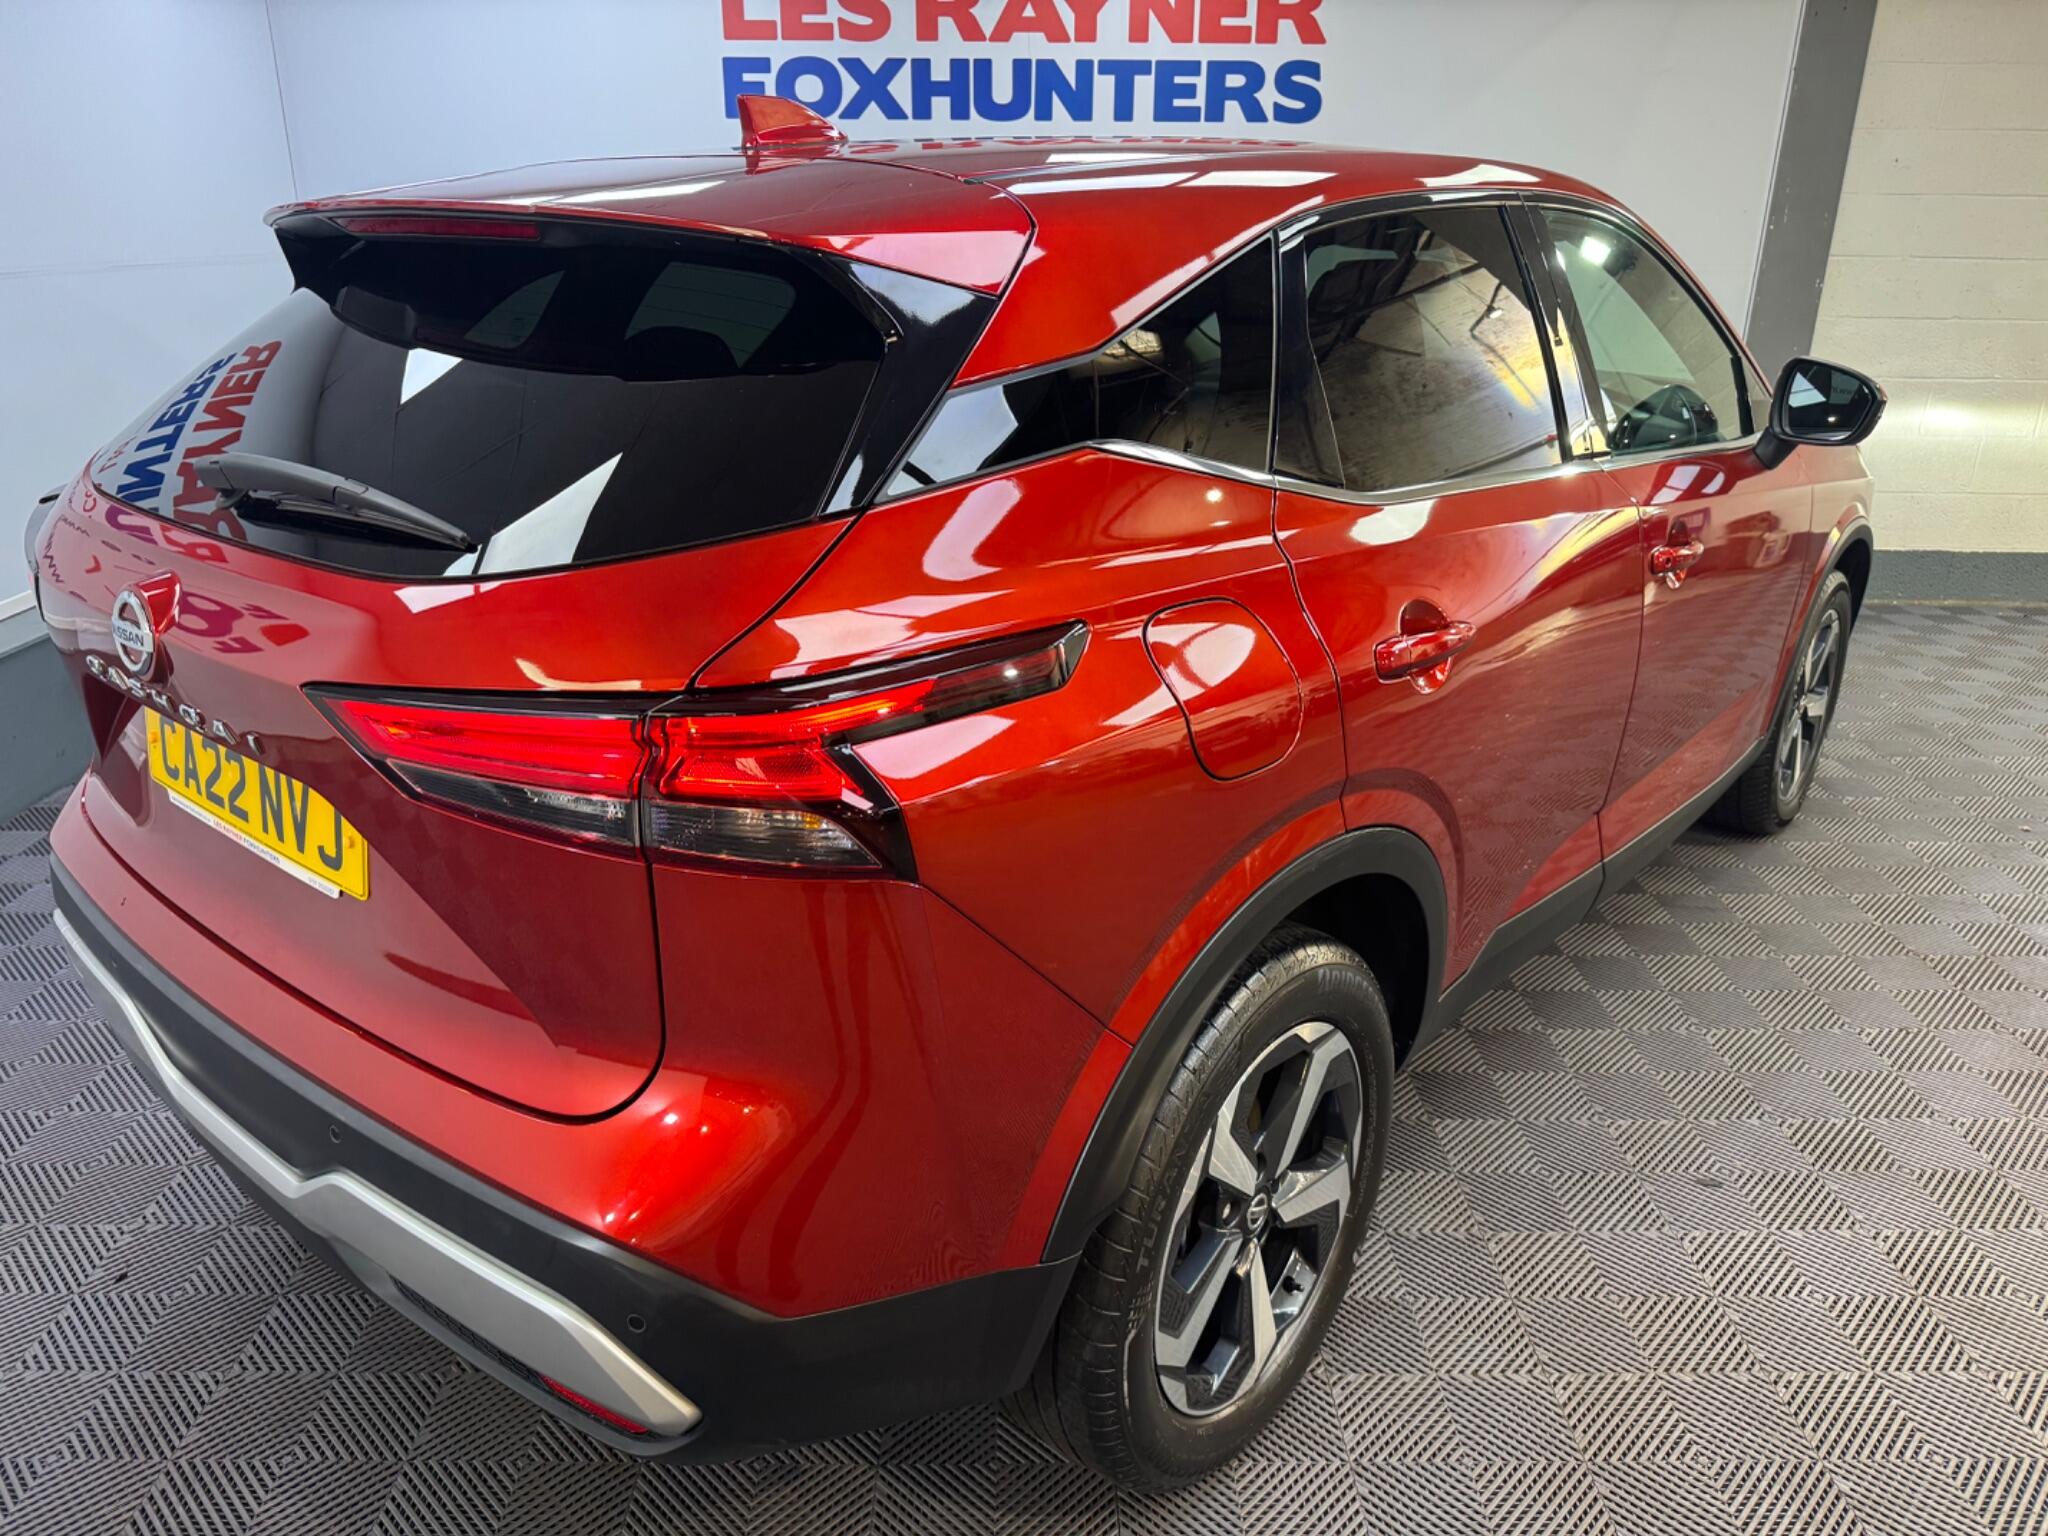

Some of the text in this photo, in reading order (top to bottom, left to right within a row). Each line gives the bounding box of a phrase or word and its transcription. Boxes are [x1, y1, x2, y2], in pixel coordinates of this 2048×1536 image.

[721, 0, 1327, 45] LES RAYNER
[721, 56, 1323, 125] FOXHUNTERS
[114, 624, 145, 647] SSAN
[160, 714, 343, 872] CA22 NVJ
